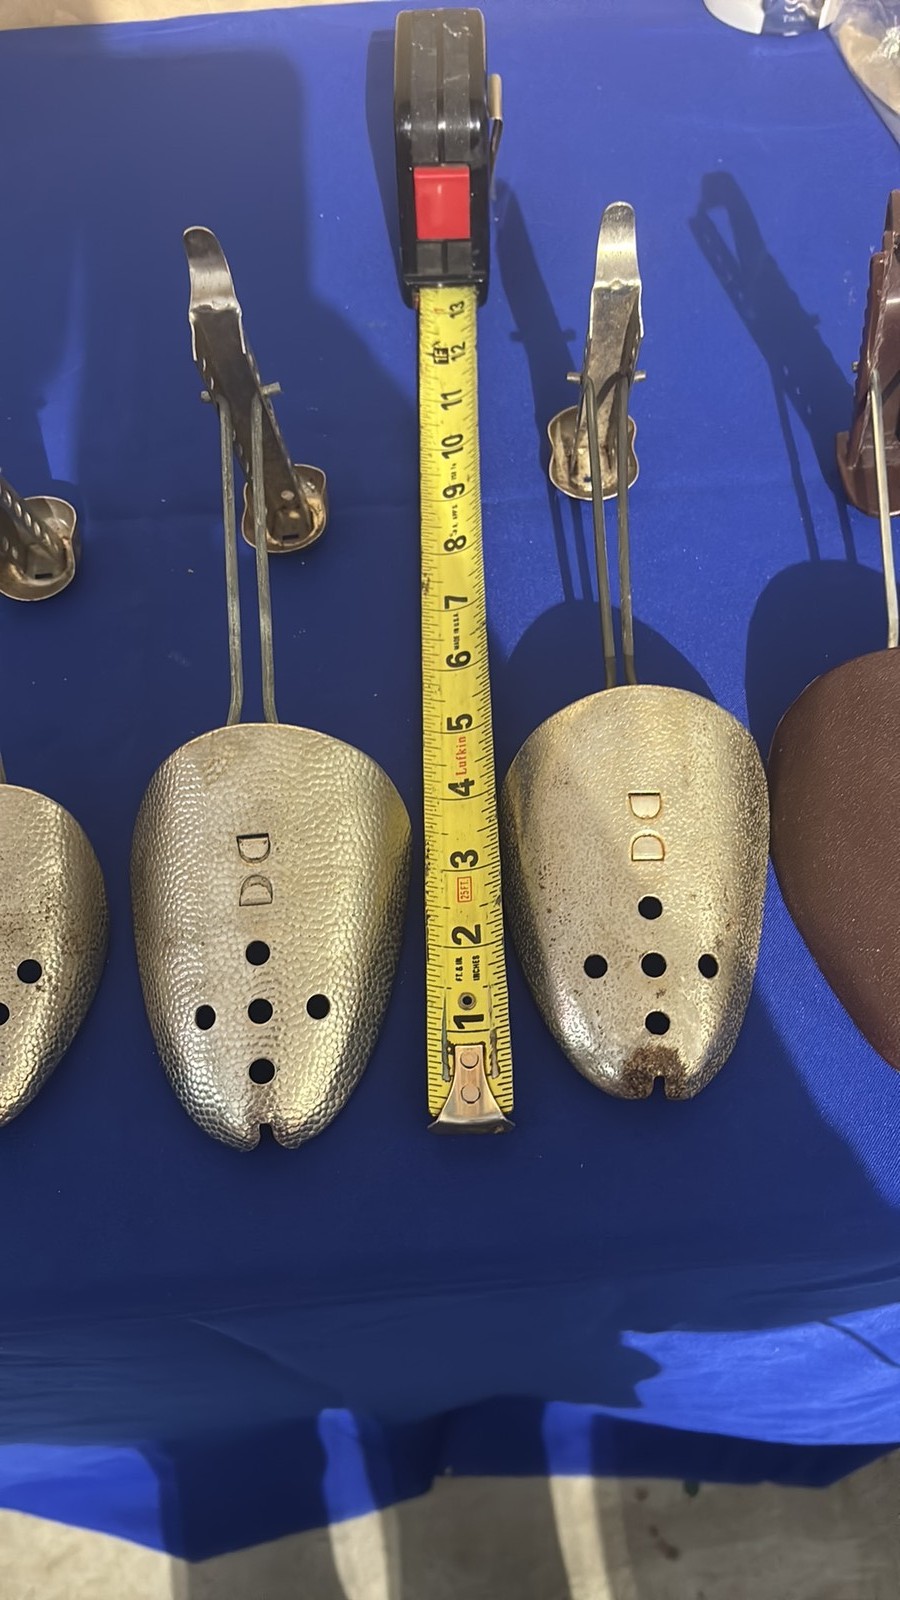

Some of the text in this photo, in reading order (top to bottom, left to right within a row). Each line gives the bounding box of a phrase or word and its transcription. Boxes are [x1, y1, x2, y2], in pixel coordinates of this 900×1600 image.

[449, 301, 465, 319] 13
[450, 341, 466, 361] 12
[440, 389, 463, 411] 11
[441, 433, 464, 460] 10
[442, 482, 466, 499] 9
[443, 535, 467, 552] 8
[444, 595, 469, 610] 7
[445, 650, 472, 668] 6
[446, 713, 473, 732] 5
[456, 736, 468, 776] Lufkin
[448, 778, 475, 797] 4
[450, 849, 479, 869] 3
[451, 923, 482, 946] 2
[472, 954, 481, 981] INCHES
[453, 1013, 485, 1030] 1
